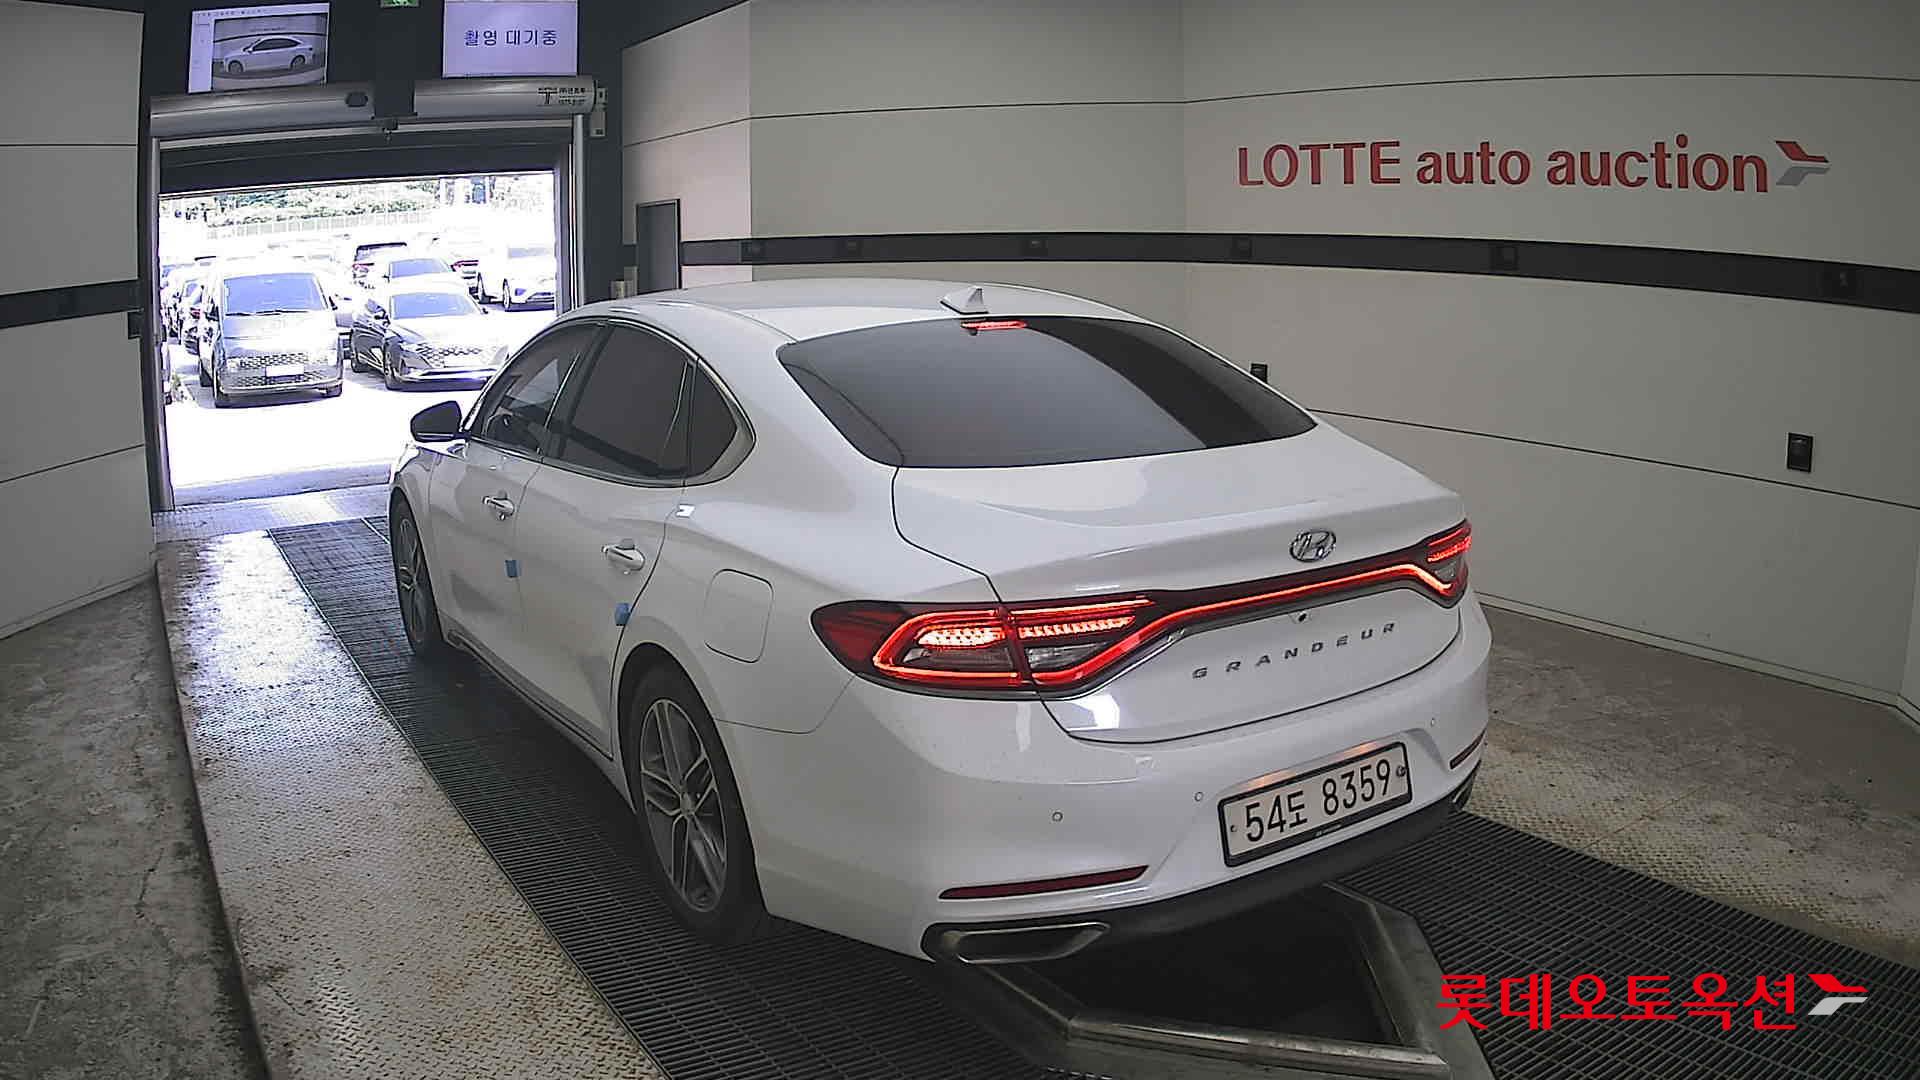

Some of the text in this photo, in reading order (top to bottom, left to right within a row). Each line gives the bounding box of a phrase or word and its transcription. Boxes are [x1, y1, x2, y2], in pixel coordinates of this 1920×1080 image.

[464, 29, 559, 47] 촬영 대기중
[1237, 133, 1769, 194] LOTTE auto auction
[1191, 621, 1397, 681] GRANDEUR
[1244, 758, 1392, 843] 54도 8359
